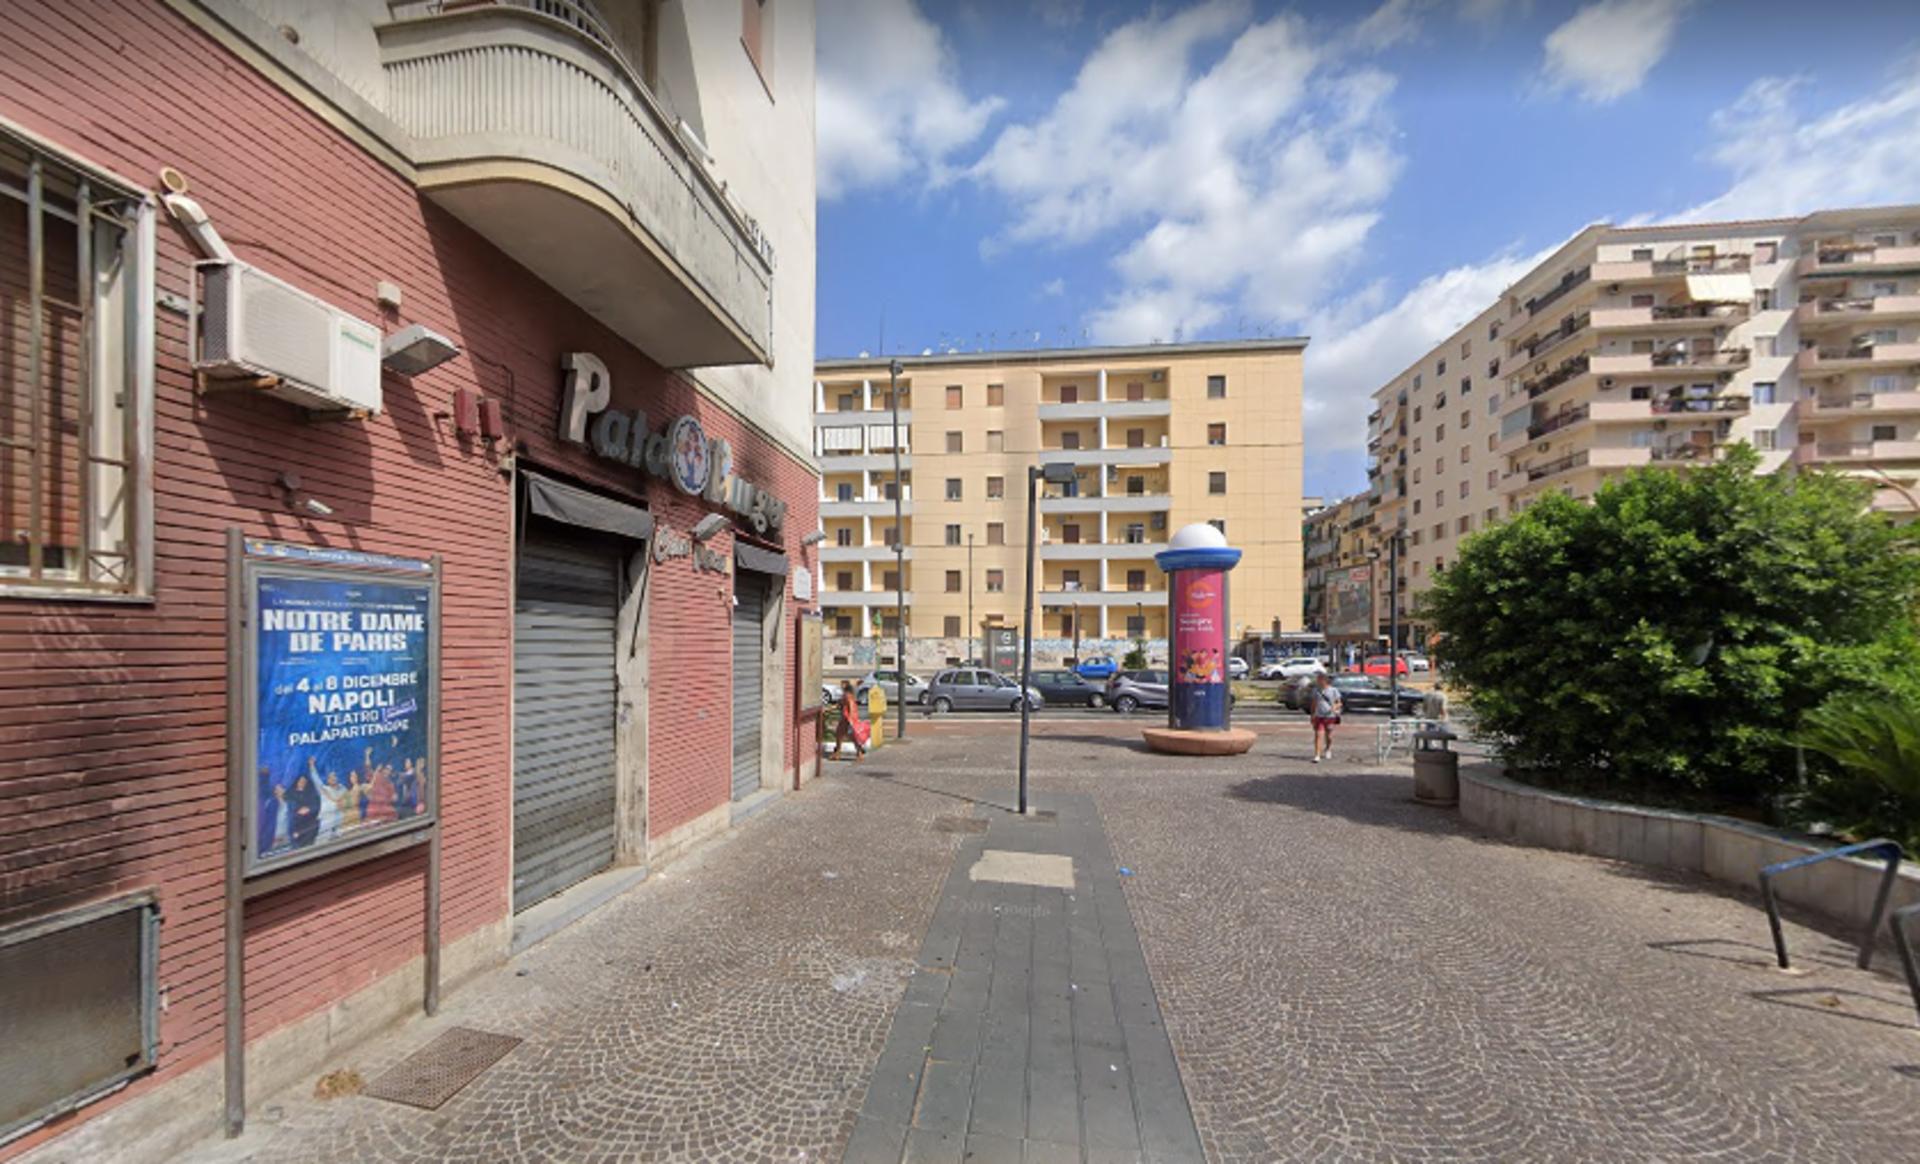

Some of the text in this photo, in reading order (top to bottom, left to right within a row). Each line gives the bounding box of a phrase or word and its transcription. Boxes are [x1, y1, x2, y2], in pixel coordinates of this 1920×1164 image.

[262, 609, 425, 632] NOTRE DAME
[289, 632, 407, 652] DE PARIS
[296, 677, 310, 692] 4
[325, 675, 339, 691] 8
[342, 671, 418, 689] DICEMBRE
[308, 689, 395, 714] NAPOLI
[323, 709, 379, 728] TEATRO
[288, 718, 410, 747] PALAPARTENOPE
